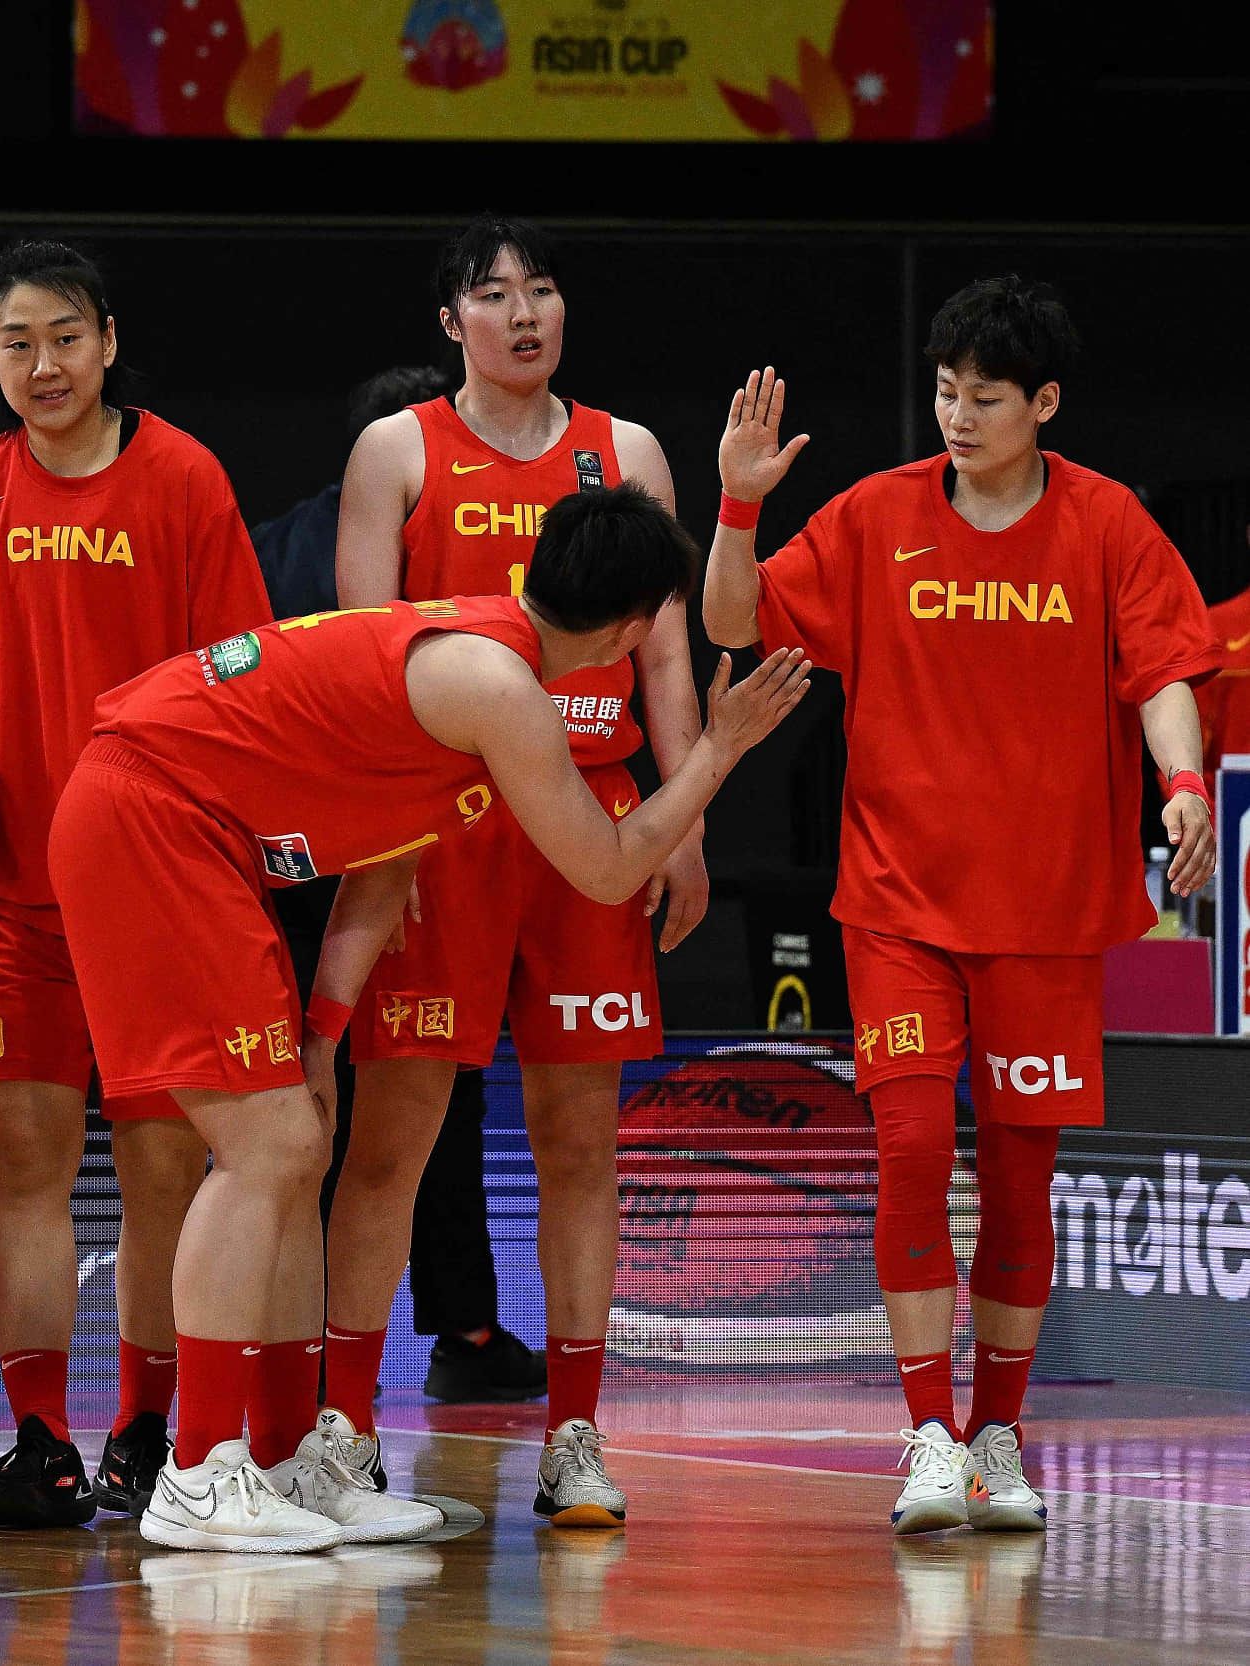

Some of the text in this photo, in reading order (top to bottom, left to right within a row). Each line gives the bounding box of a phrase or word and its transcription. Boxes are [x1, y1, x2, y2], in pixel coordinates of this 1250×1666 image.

[534, 36, 687, 74] ASIA CUP
[581, 474, 601, 486] FIBA
[455, 502, 549, 537] CHI
[7, 525, 135, 567] CHINA
[909, 580, 1074, 624] CHINA
[550, 694, 623, 721] 国银联
[564, 719, 615, 739] nionPay
[382, 997, 455, 1039] 中国
[549, 992, 650, 1032] TCL
[224, 1019, 296, 1070] 中国
[857, 1012, 925, 1064] 中国
[986, 1052, 1083, 1095] TCL
